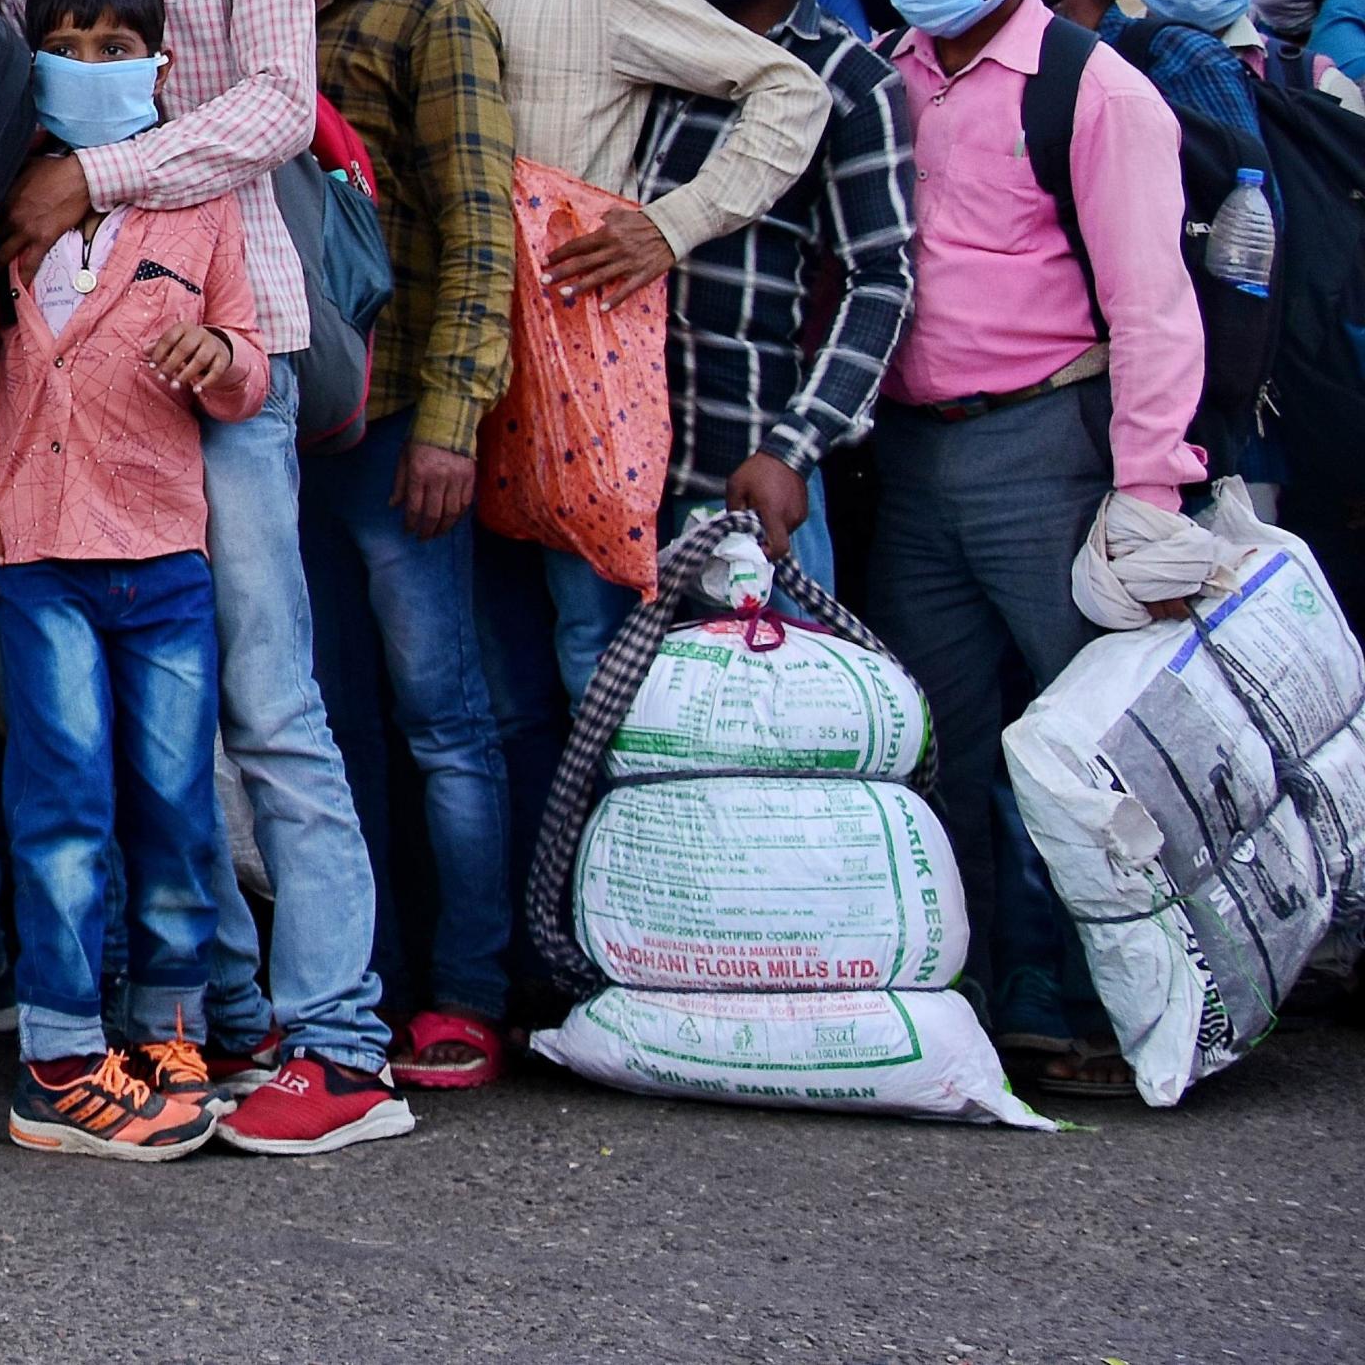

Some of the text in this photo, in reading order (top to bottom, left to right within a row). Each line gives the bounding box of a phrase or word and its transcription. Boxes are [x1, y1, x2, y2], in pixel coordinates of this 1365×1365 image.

[818, 726, 837, 740] 35
[841, 727, 859, 742] kg
[1192, 844, 1211, 869] 5
[914, 888, 943, 983] BESAN
[695, 957, 761, 978] FLOUR
[768, 959, 829, 978] MILLS
[836, 959, 879, 979] LTD.
[805, 1087, 877, 1099] BESAN
